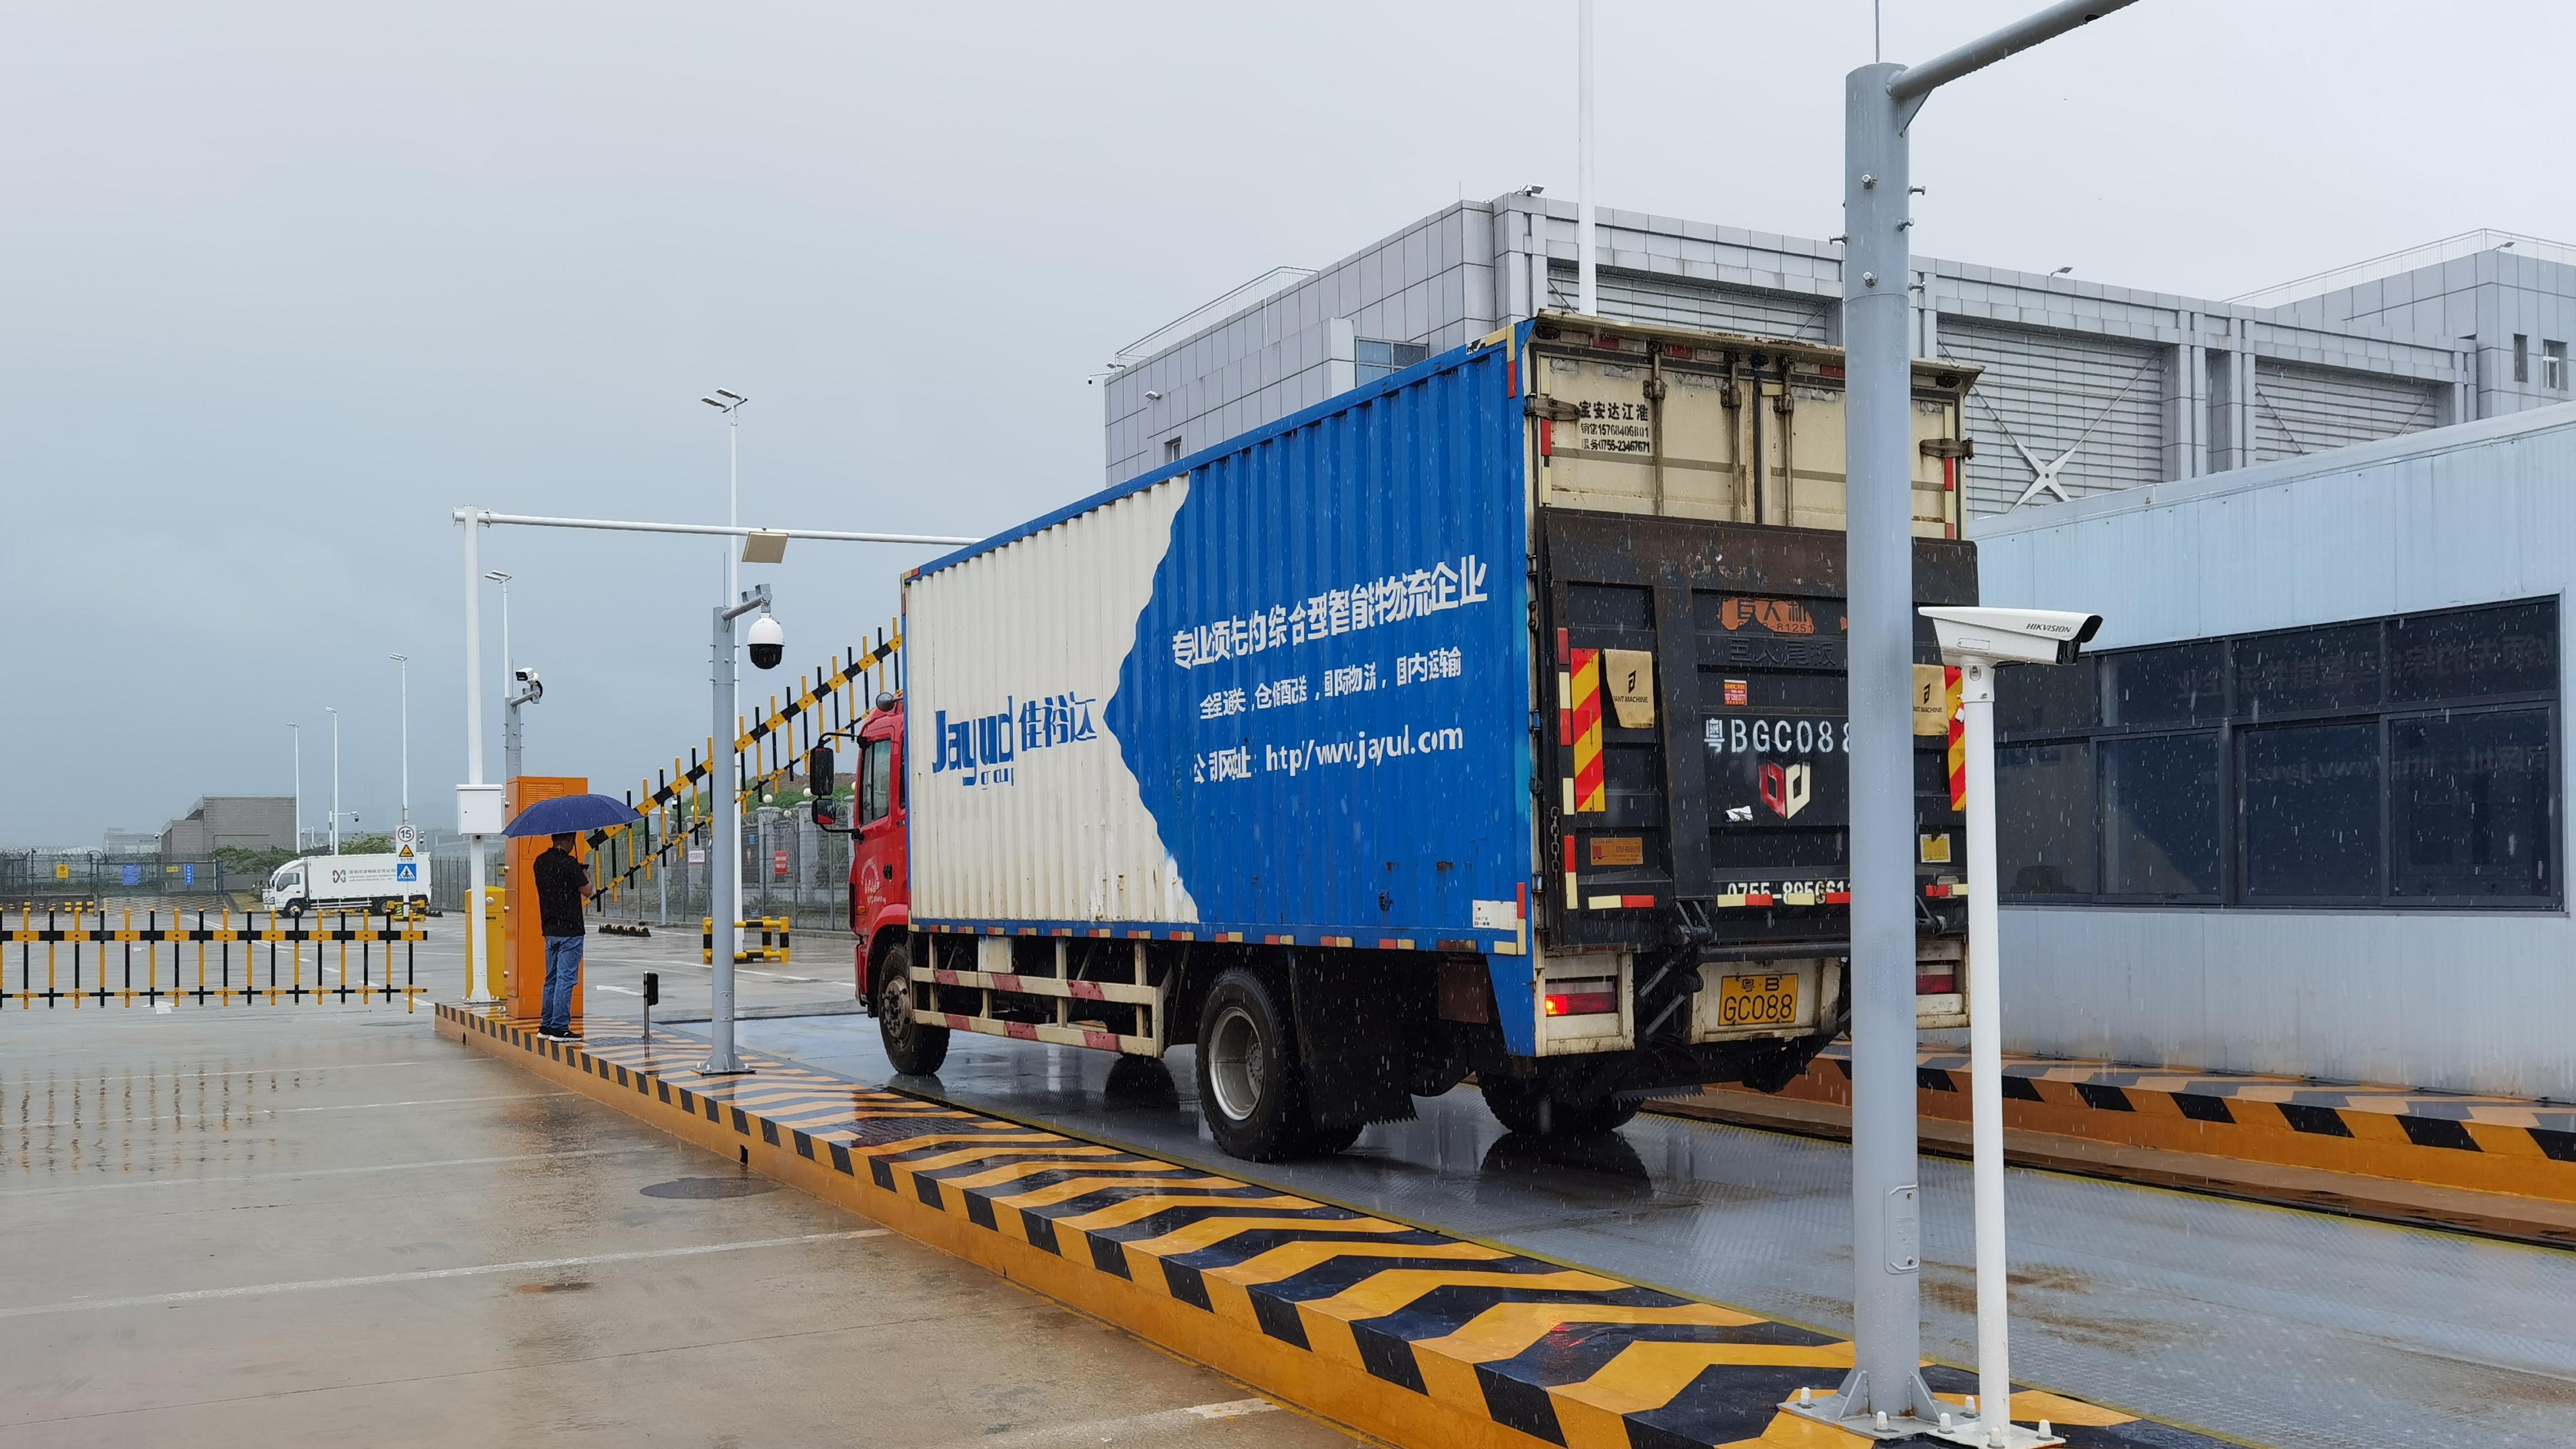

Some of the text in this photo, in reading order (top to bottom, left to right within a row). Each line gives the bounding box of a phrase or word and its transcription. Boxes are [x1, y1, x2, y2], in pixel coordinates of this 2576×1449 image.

[1579, 400, 1649, 421] 宝安达江淮
[1173, 555, 1487, 670] 专业领先的综合型智能物流企业
[2026, 623, 2072, 632] HIKVISION
[932, 691, 1097, 786] Jayud 佳裕达
[400, 830, 412, 839] 15
[1724, 993, 1793, 1021] GC088
